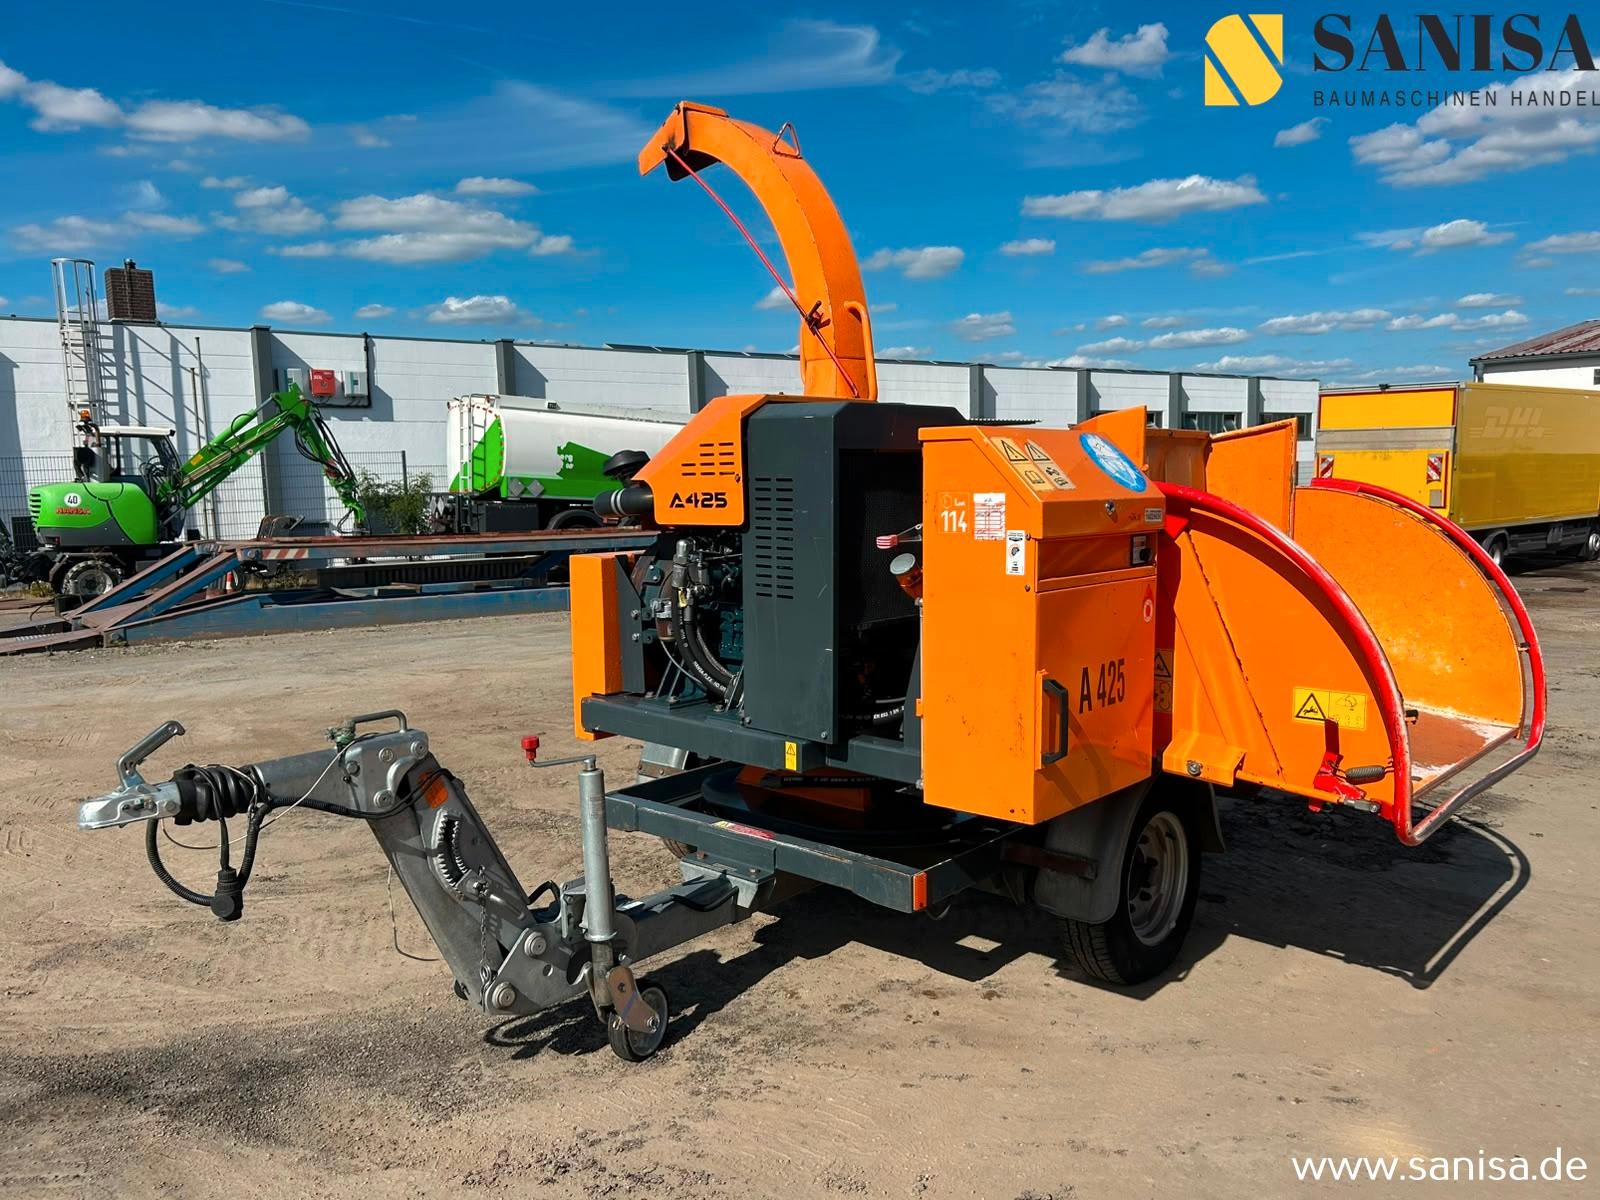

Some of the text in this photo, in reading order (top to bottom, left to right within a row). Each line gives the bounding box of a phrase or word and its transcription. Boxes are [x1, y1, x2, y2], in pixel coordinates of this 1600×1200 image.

[67, 495, 78, 505] 40
[669, 491, 728, 509] A425
[940, 509, 968, 533] 114
[1079, 658, 1126, 714] A 425
